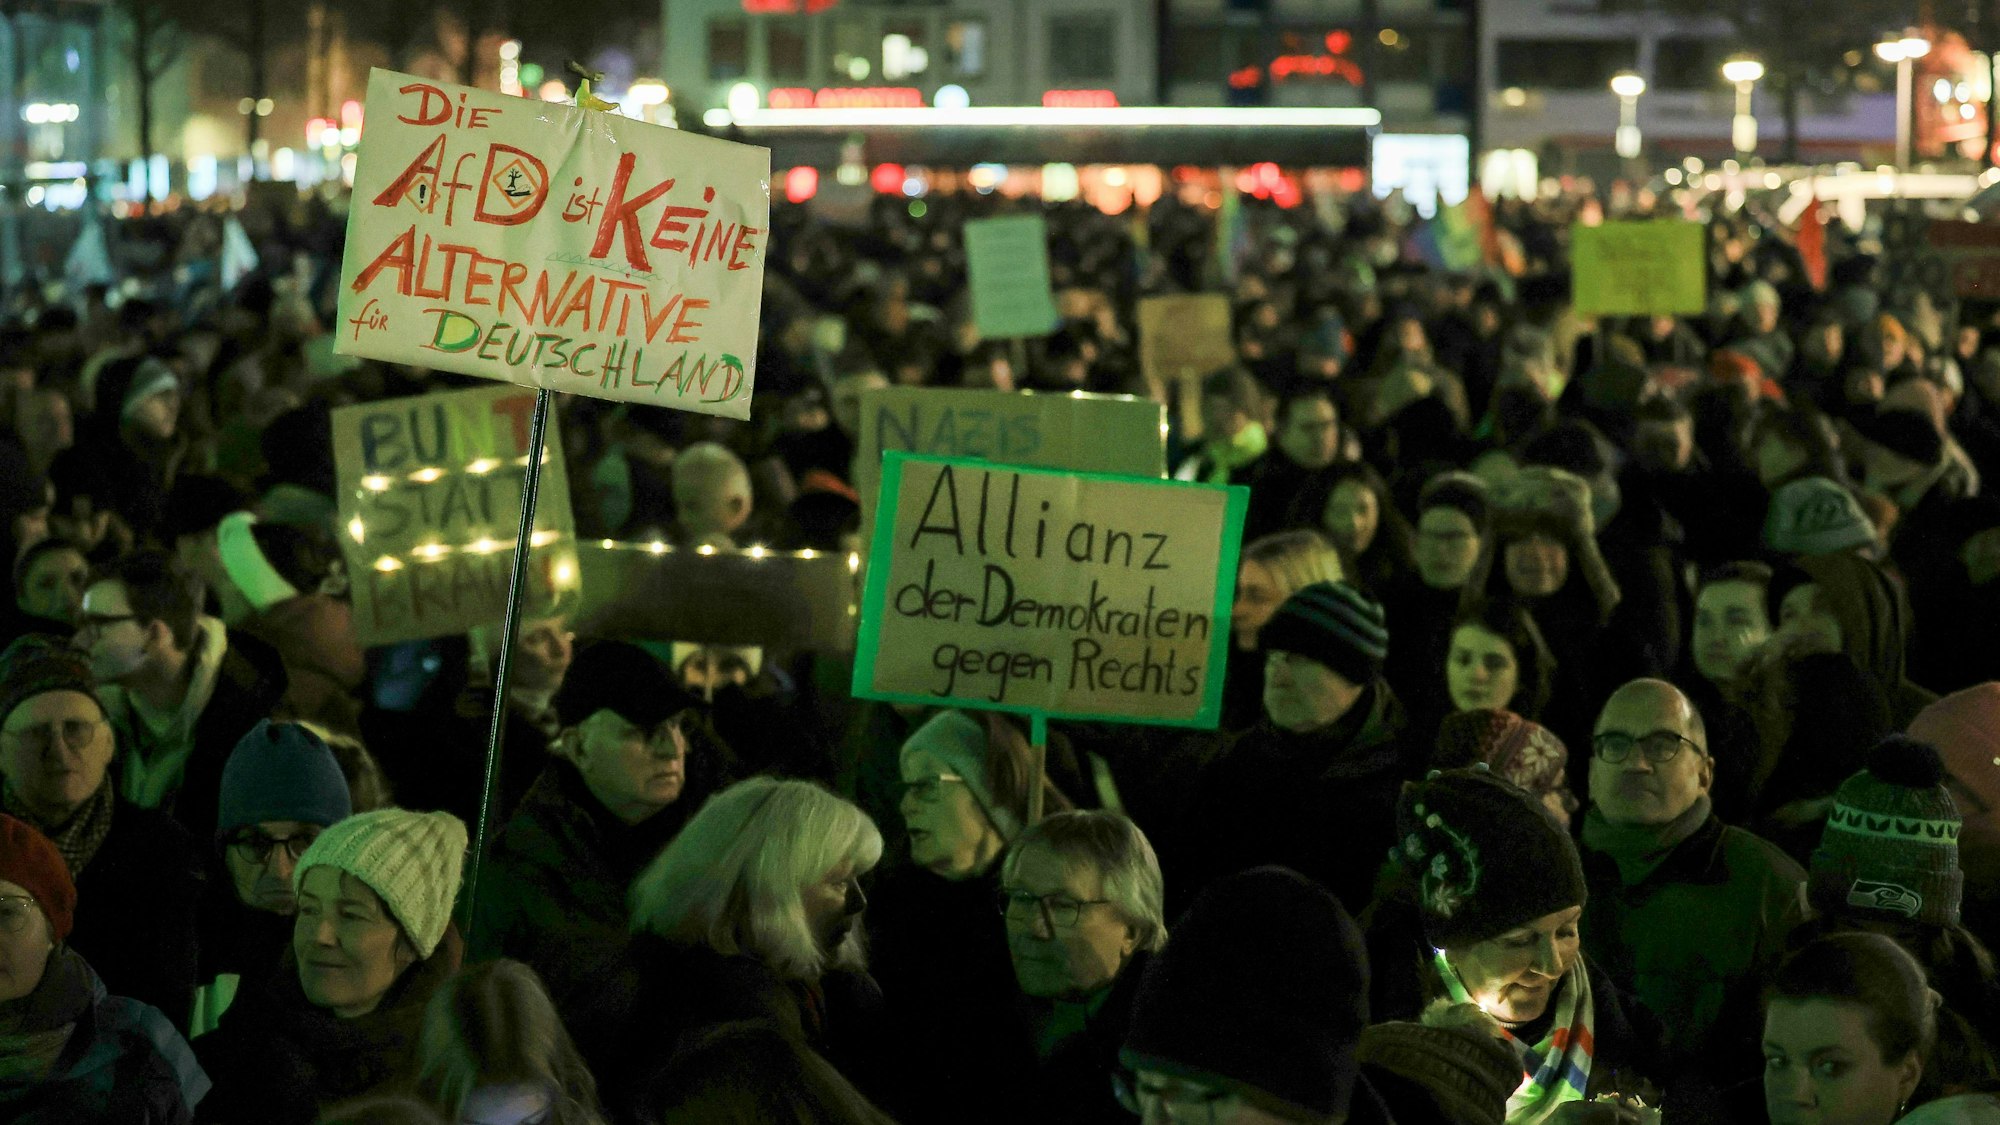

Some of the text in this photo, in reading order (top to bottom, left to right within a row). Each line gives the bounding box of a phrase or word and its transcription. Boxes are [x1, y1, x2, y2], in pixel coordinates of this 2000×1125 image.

[372, 133, 549, 226] AfD
[561, 176, 603, 224] ist
[419, 308, 744, 403] DEUTSCHLAND
[361, 394, 539, 470] BUNT
[876, 402, 1042, 461] NAZIS
[910, 464, 1171, 570] Allianz
[894, 558, 1209, 640] der Demokraten
[931, 638, 1201, 702] gegen Rechts
